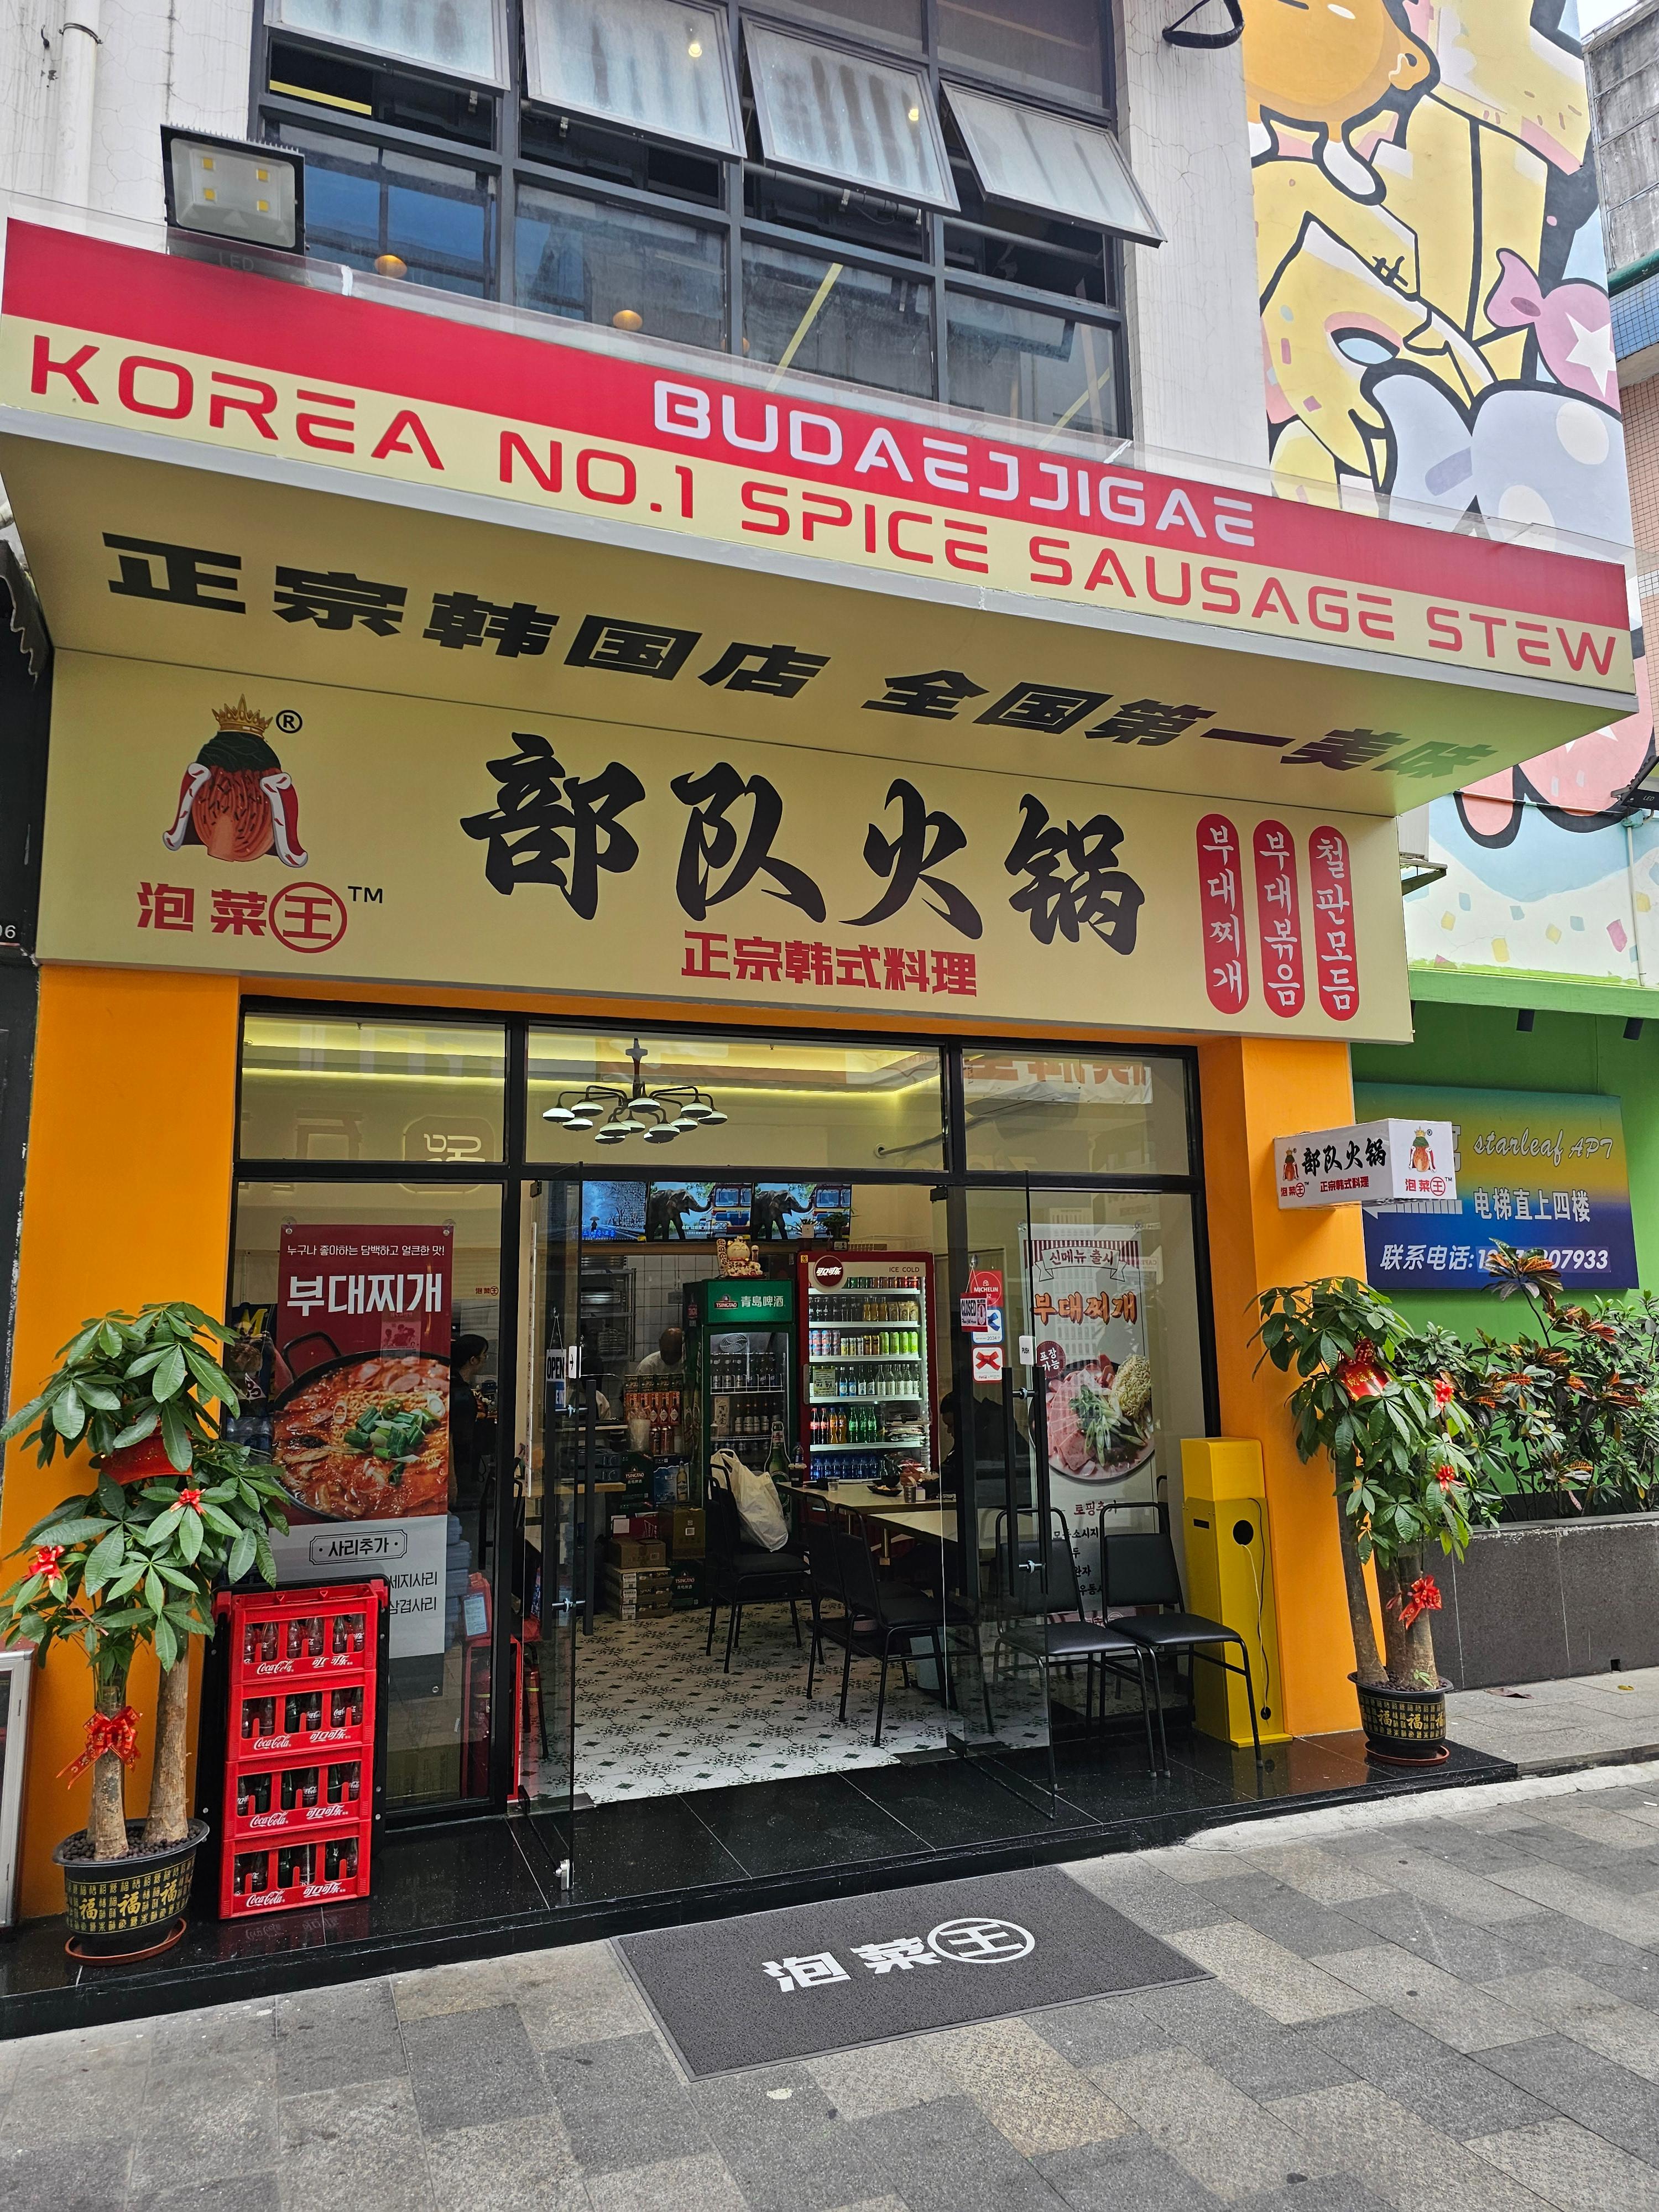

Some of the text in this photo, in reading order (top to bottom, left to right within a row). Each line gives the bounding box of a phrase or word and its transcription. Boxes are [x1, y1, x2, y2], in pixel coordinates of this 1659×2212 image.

[654, 380, 1254, 546] BUDAEJJIGAE
[31, 335, 1615, 675] KOREA NO.1 SPICE SAUSAGE STEW
[102, 532, 1498, 778] 正宗韩国店 全国第一美味
[460, 733, 1145, 955] 部队火锅
[0, 924, 16, 938] 6
[137, 881, 347, 953] 泡菜王
[1203, 825, 1243, 1004] 부대찌개
[1259, 831, 1301, 1008] 부대볶음
[1315, 836, 1356, 1012] 철판모듬
[681, 930, 977, 997] 正宗韩式料理
[1301, 1138, 1387, 1177] 部队火锅
[1473, 1127, 1564, 1167] starleaf
[1568, 1137, 1614, 1159] APT
[1281, 1182, 1305, 1198] 泡菜王
[1320, 1176, 1369, 1192] 正宗韩式料理
[1405, 1176, 1446, 1196] 泡菜王
[1473, 1187, 1590, 1223] 电梯直上四楼
[287, 1245, 445, 1256] 누구나 좋아하는 담백하고 얼큰한 맛!
[1050, 1249, 1114, 1266] 신메뉴 출시
[1478, 1248, 1609, 1270] 107933
[287, 1274, 442, 1317] 부대찌개
[962, 1300, 977, 1317] CLOSED
[1034, 1291, 1138, 1327] 부대찌개
[547, 1357, 565, 1379] OPEN
[1040, 1347, 1057, 1361] 포장
[1042, 1359, 1060, 1372] 가능
[328, 1537, 389, 1557] 사리추가
[389, 1572, 437, 1589] 세지사리
[1406, 1713, 1423, 1730] 福
[79, 1879, 178, 1920] 福 福 福
[762, 1917, 1035, 1992] 泡菜王
